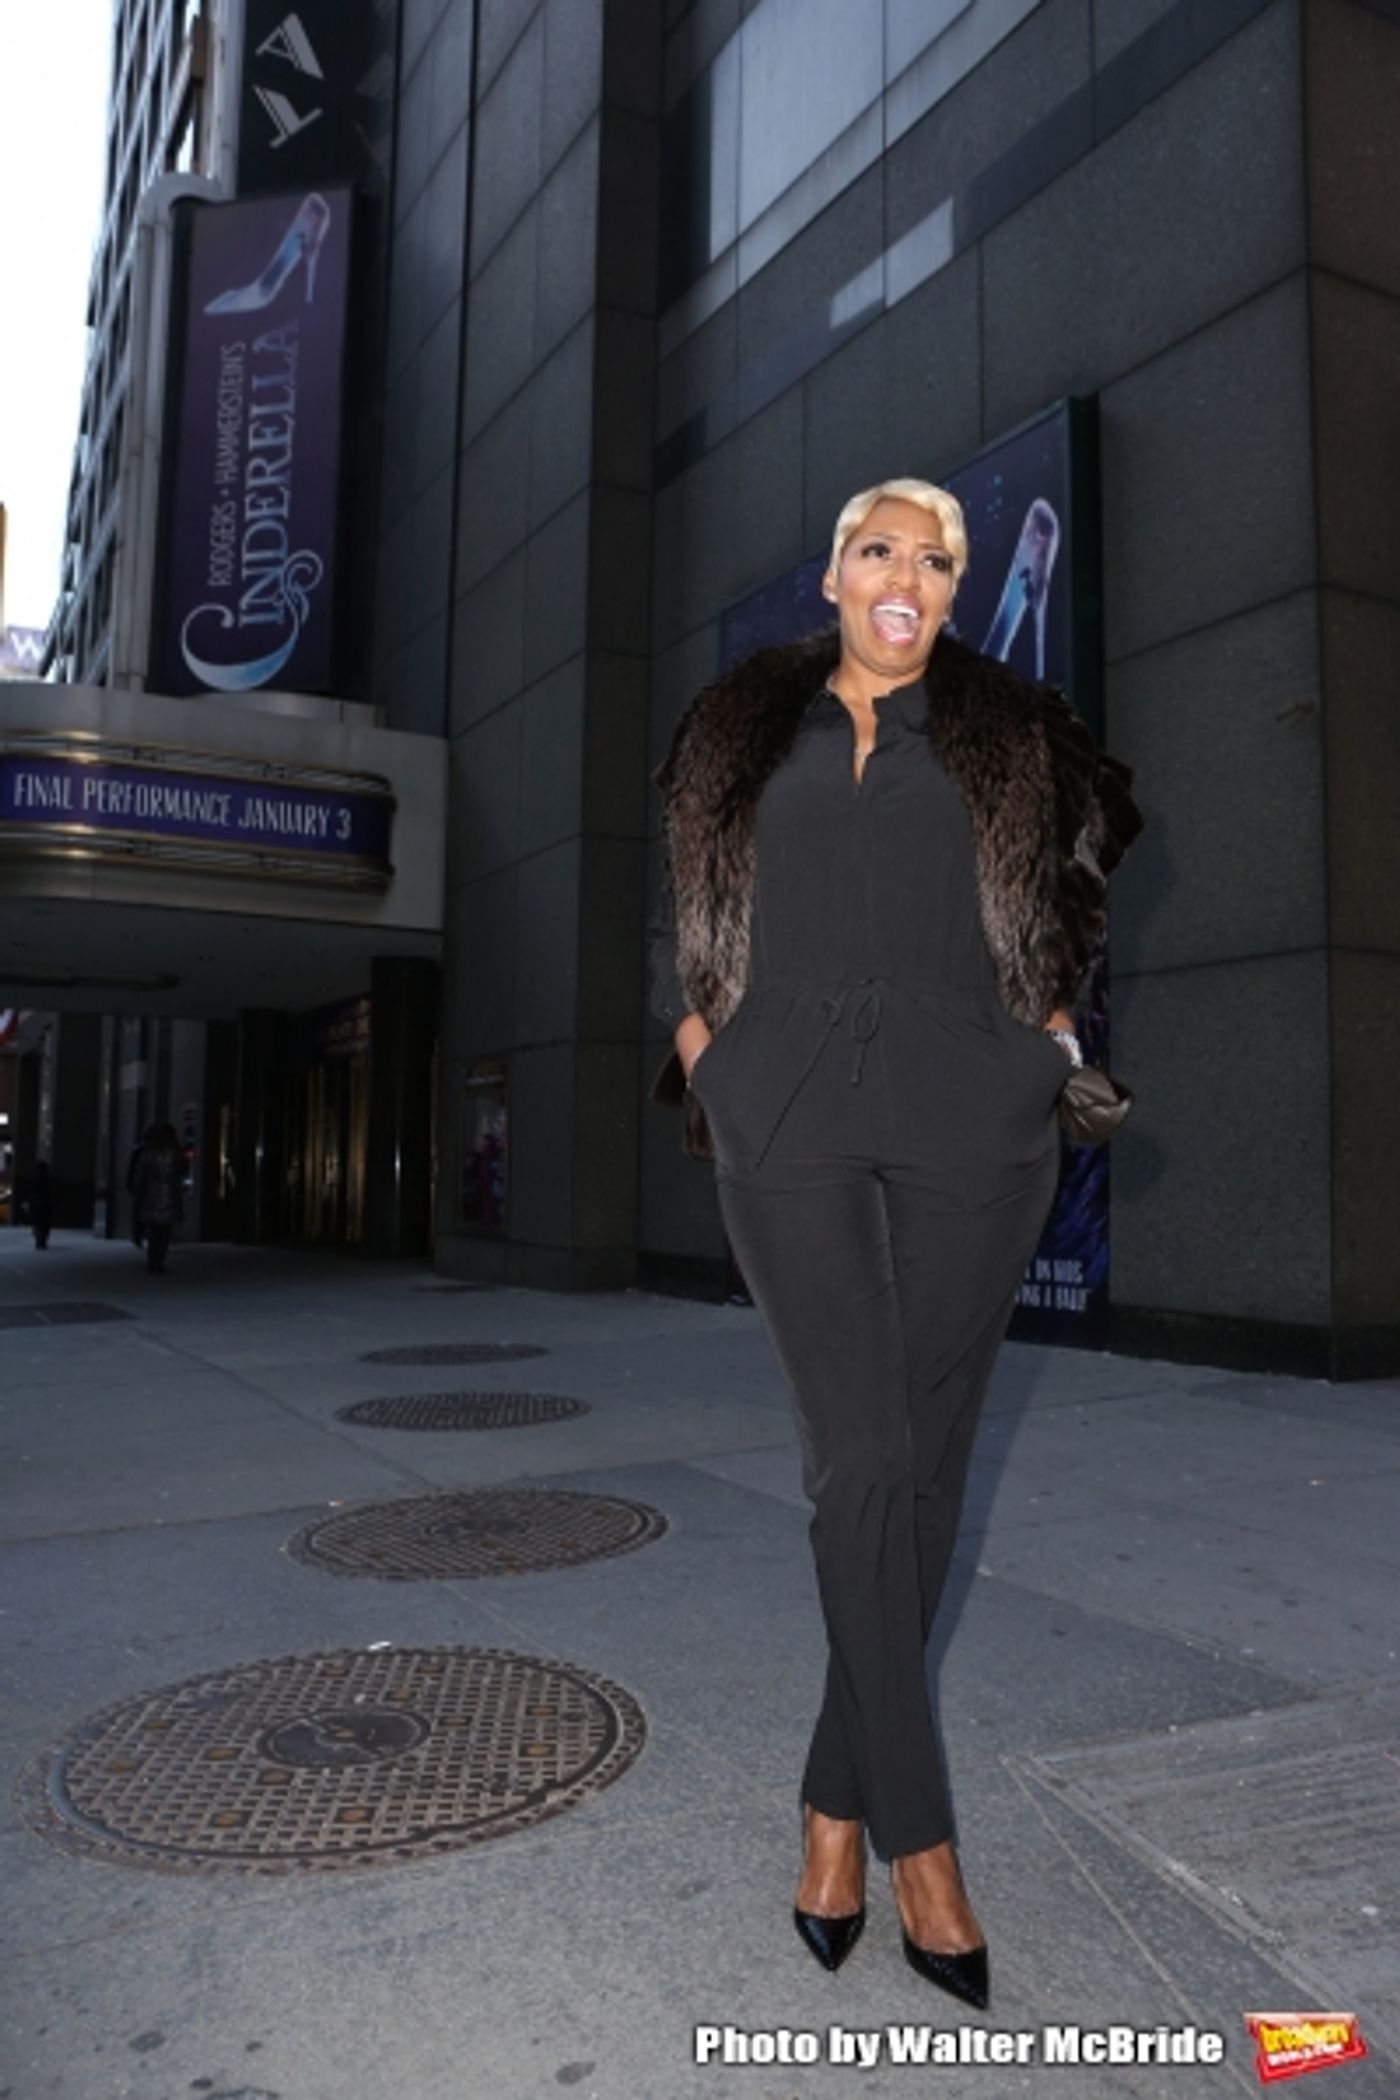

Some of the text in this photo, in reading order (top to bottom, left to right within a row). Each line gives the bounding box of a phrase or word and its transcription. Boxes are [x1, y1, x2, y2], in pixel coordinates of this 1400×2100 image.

[181, 318, 323, 691] CINDERELLA
[208, 500, 237, 587] RODGERS
[13, 772, 352, 841] FINAL PERFORMANCE JANUARY 3
